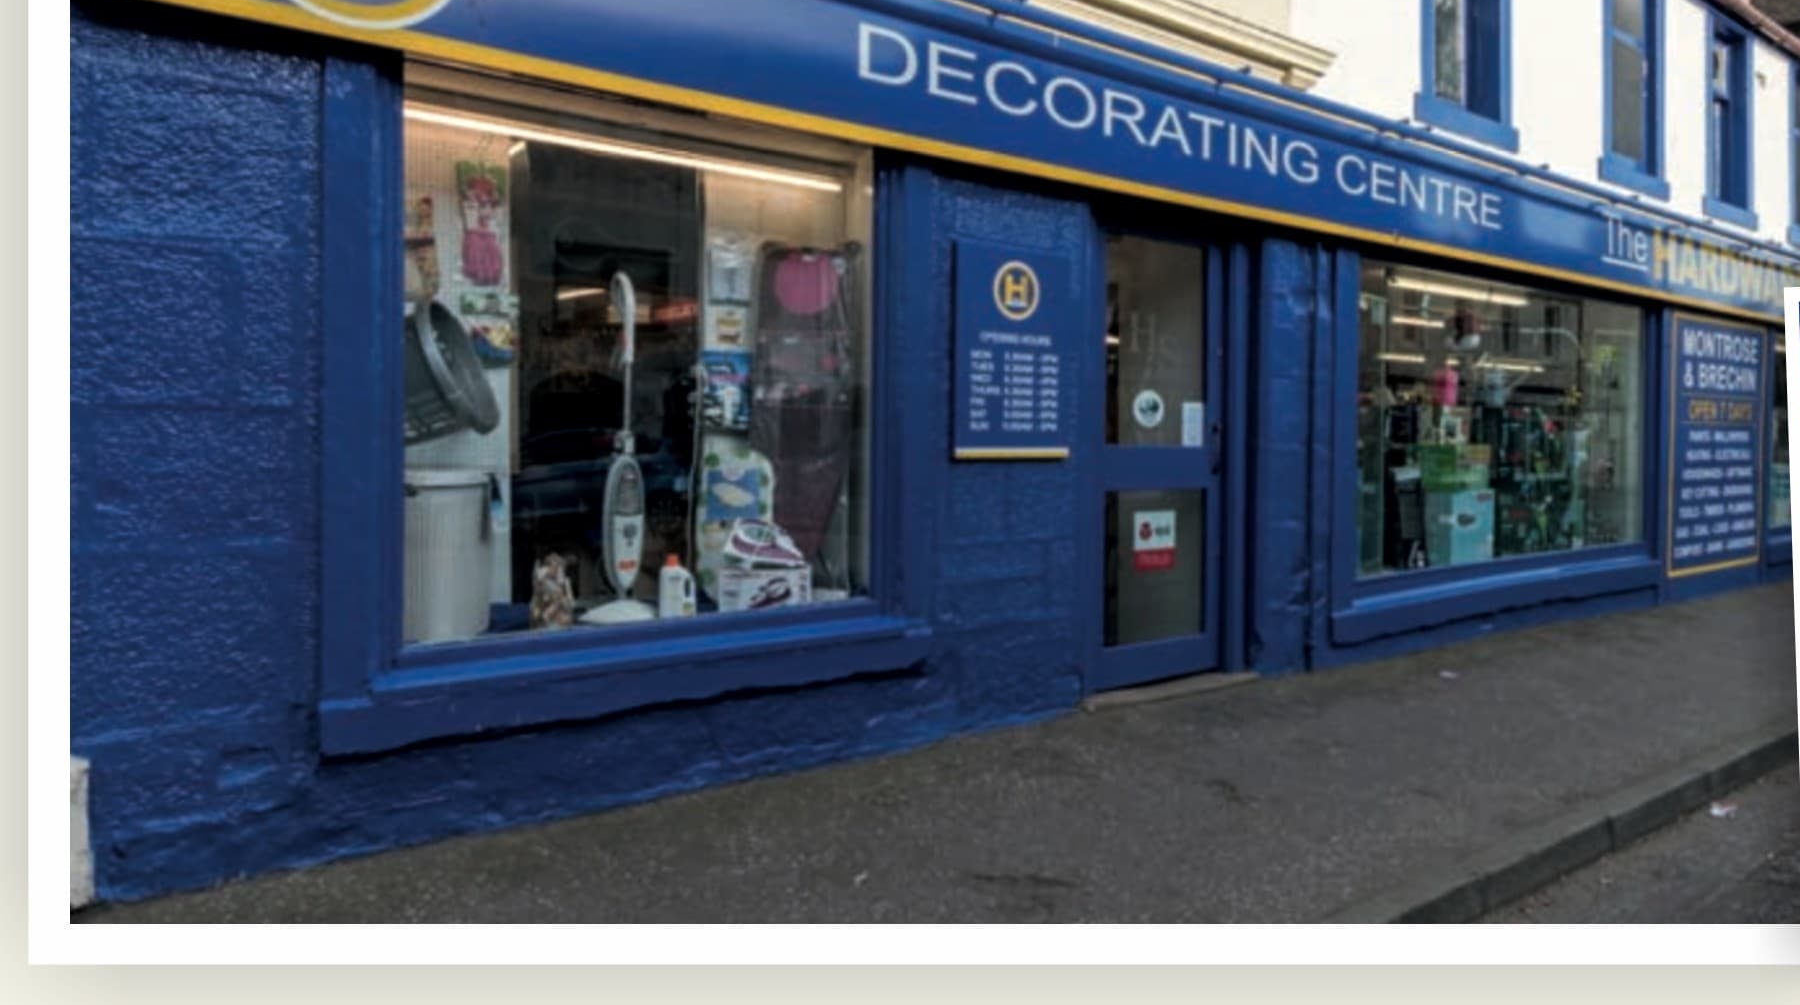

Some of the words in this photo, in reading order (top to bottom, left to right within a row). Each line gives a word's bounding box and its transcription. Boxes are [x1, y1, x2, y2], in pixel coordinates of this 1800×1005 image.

[857, 22, 1321, 185] DECORATING
[1334, 154, 1504, 232] CENTRE
[1606, 214, 1649, 263] The
[1004, 272, 1029, 307] H
[1683, 328, 1759, 364] MONTROSE
[1684, 361, 1694, 388] &
[1699, 363, 1757, 391] BRECHIN
